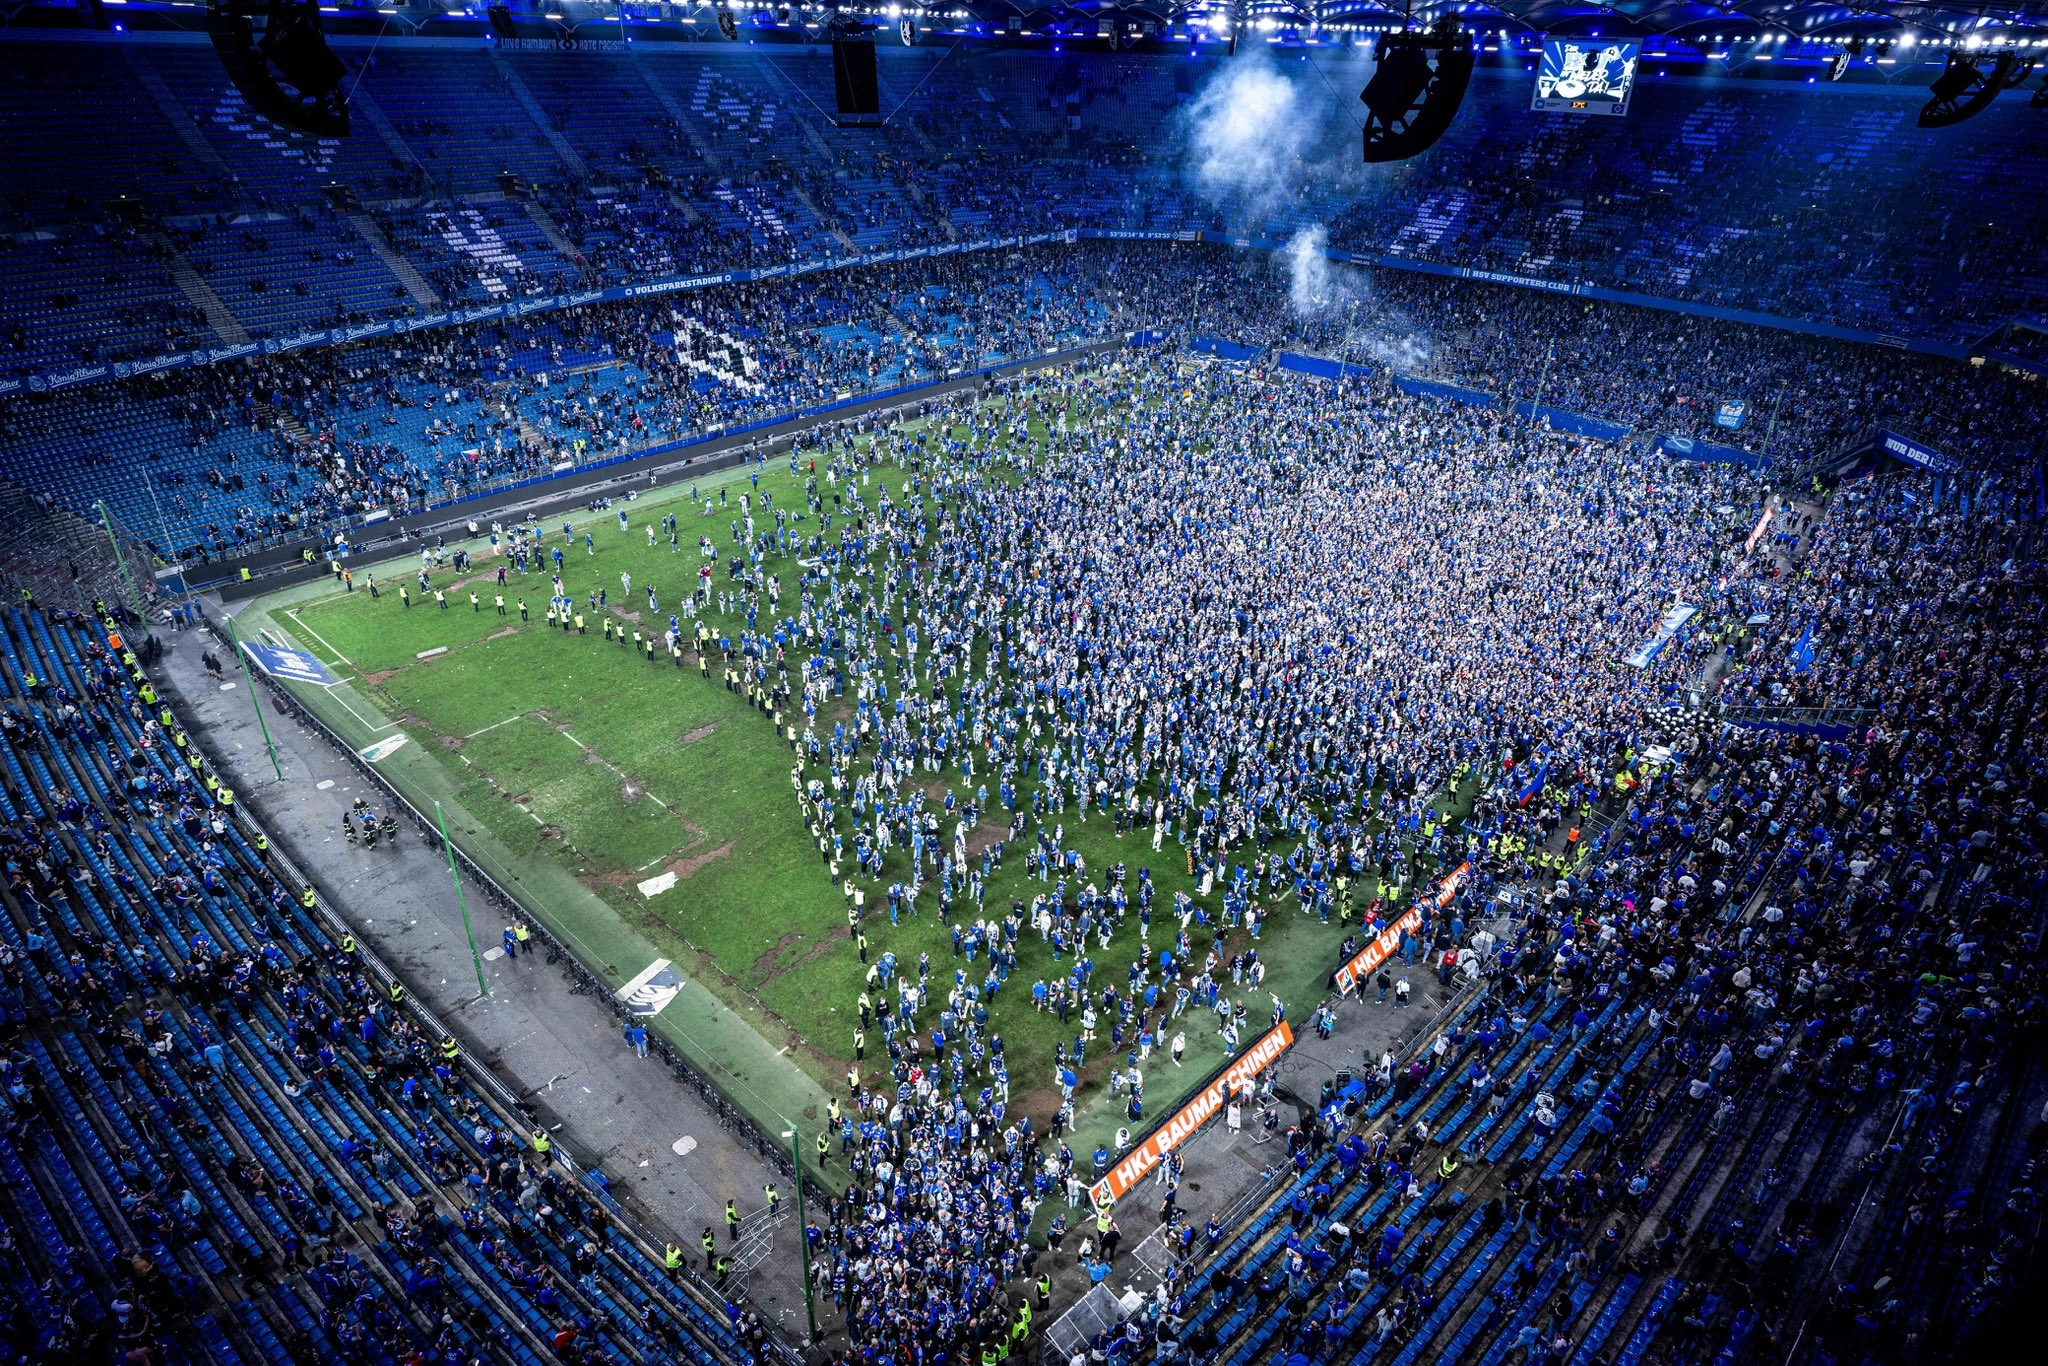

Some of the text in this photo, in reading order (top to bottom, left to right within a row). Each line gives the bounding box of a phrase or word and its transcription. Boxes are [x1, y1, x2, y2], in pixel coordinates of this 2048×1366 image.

[635, 275, 723, 295] VOLKSPARKSTADION
[1472, 269, 1570, 292] HSV SUPPORTERS CLUB
[1884, 437, 1908, 455] NUR
[1907, 447, 1930, 465] DER
[1353, 948, 1382, 975] HKL
[1116, 1145, 1158, 1189] HKL
